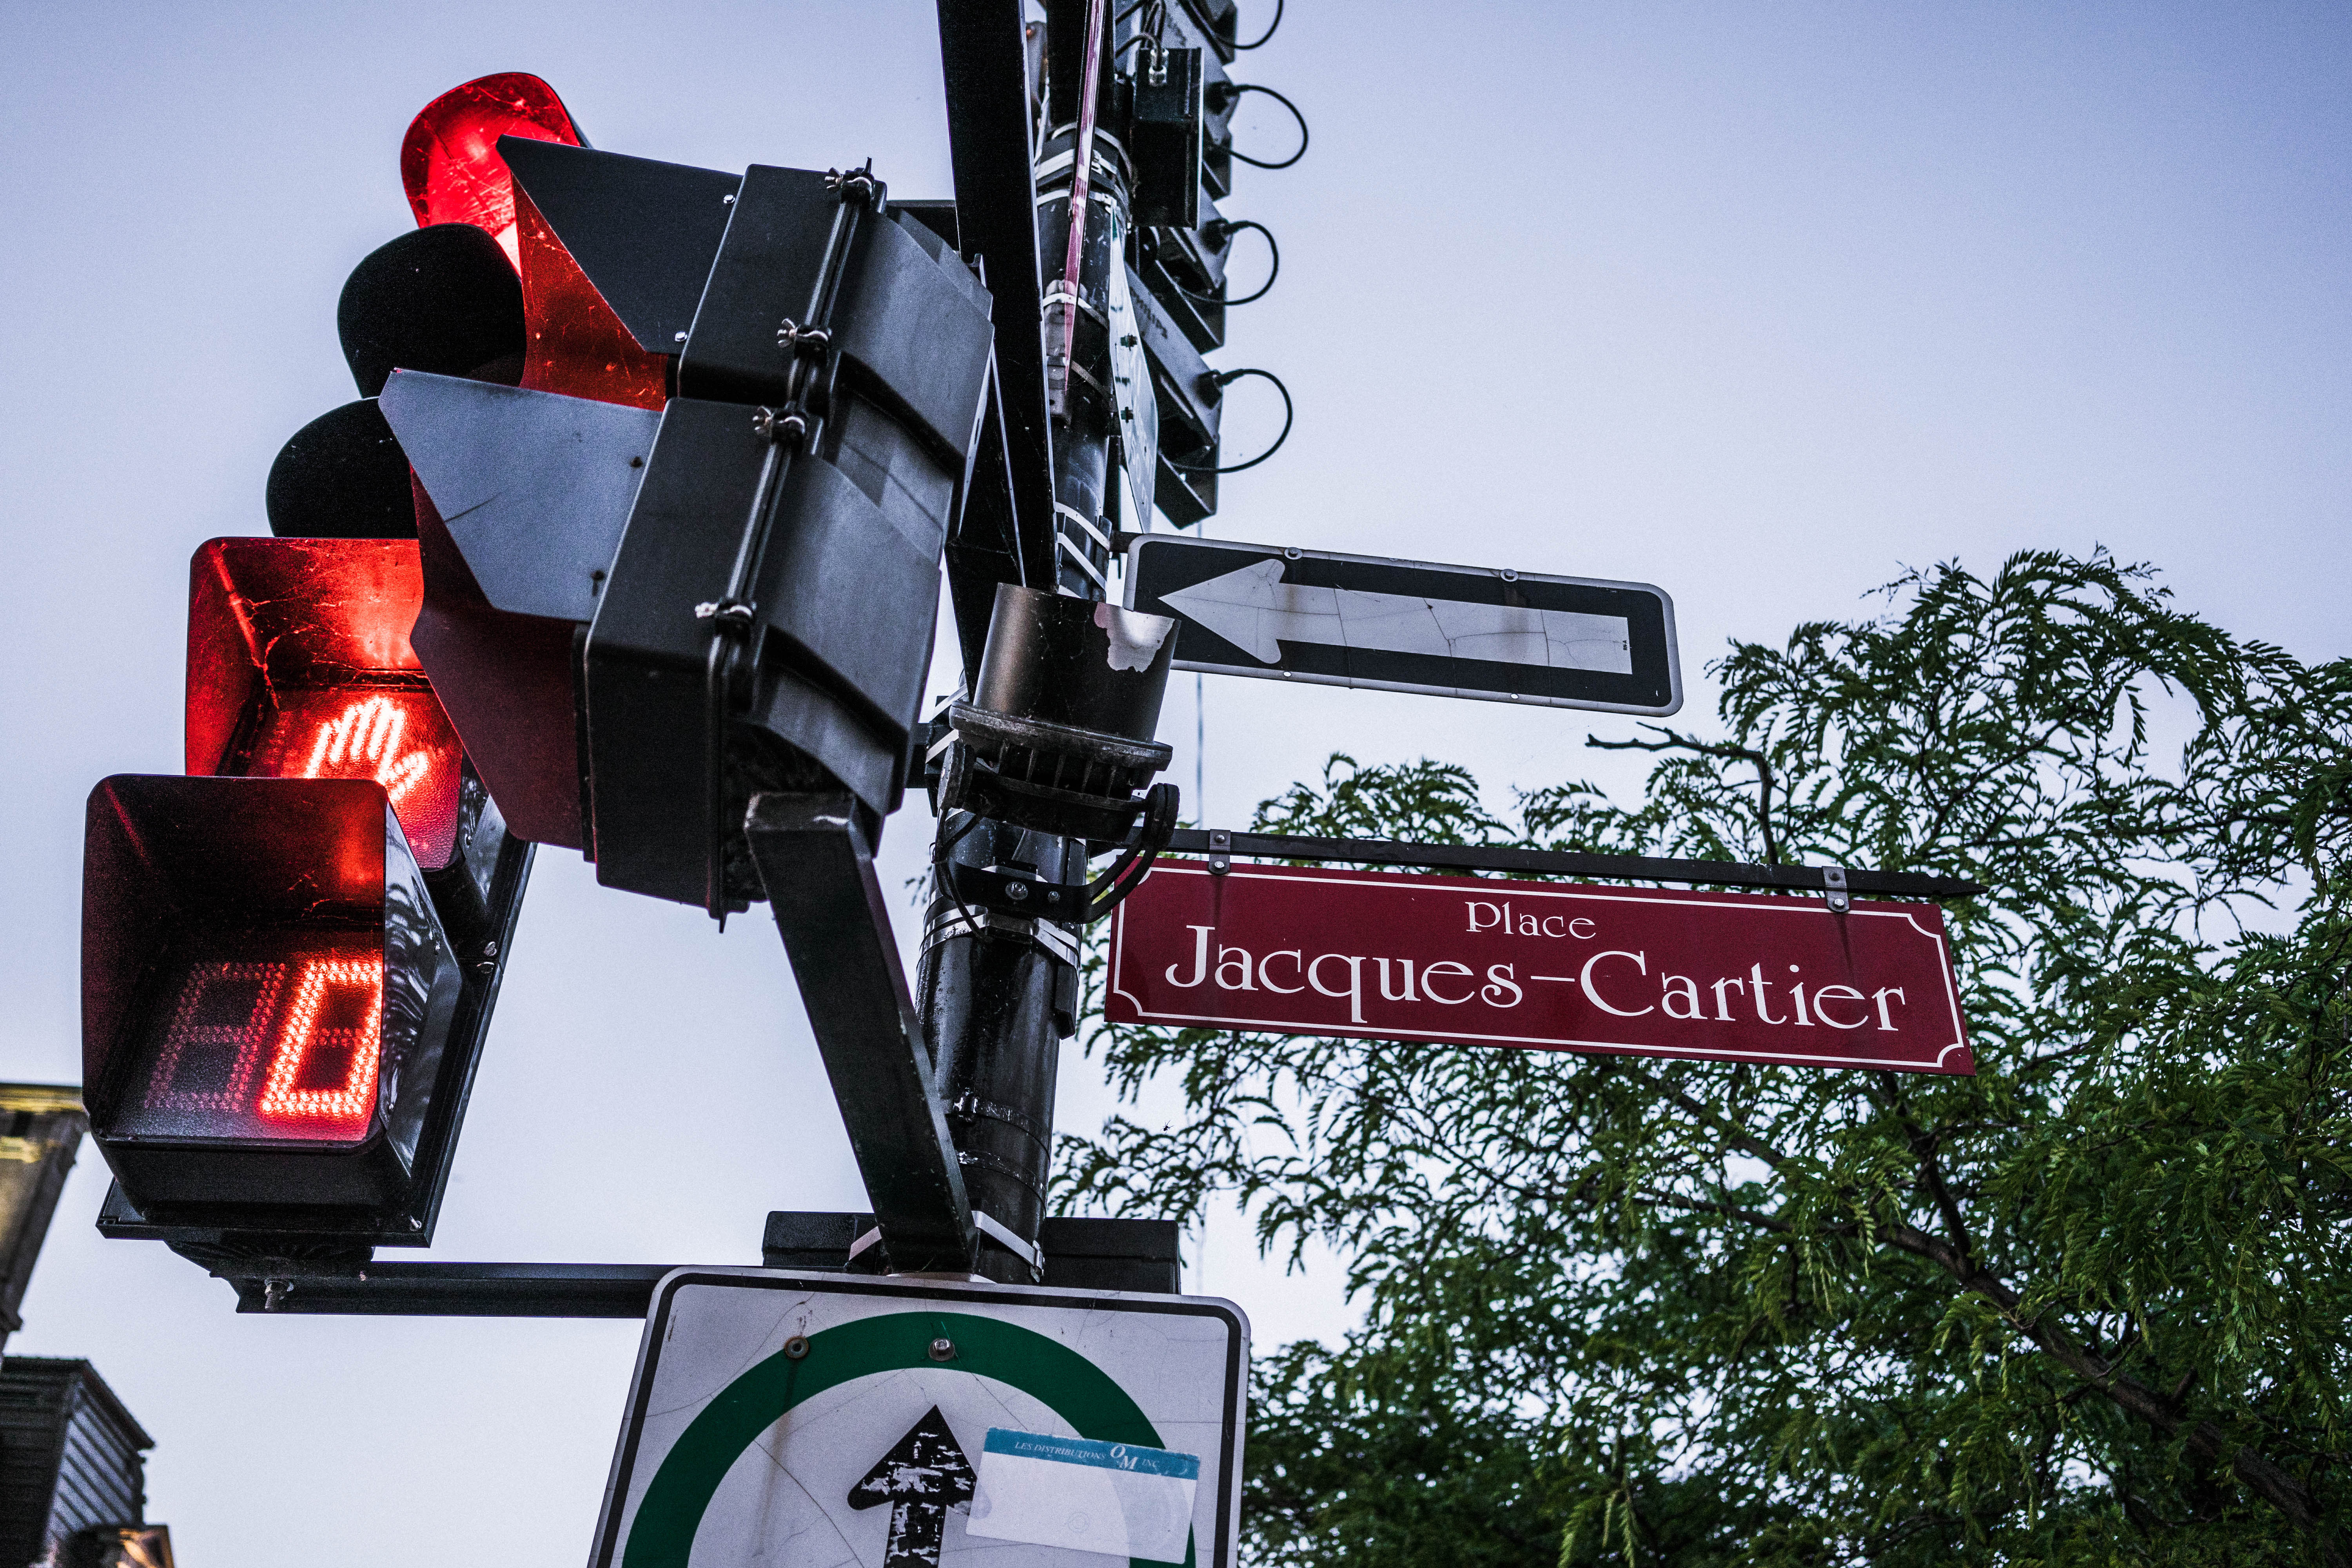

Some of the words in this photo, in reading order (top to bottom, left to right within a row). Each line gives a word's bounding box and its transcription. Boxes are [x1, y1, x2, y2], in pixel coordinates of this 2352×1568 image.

[1465, 901, 1596, 939] Place
[1165, 925, 1906, 1031] Jacques-Cartier
[1015, 1442, 1033, 1450] LES
[1034, 1444, 1106, 1460] DISTRIBUTIONS
